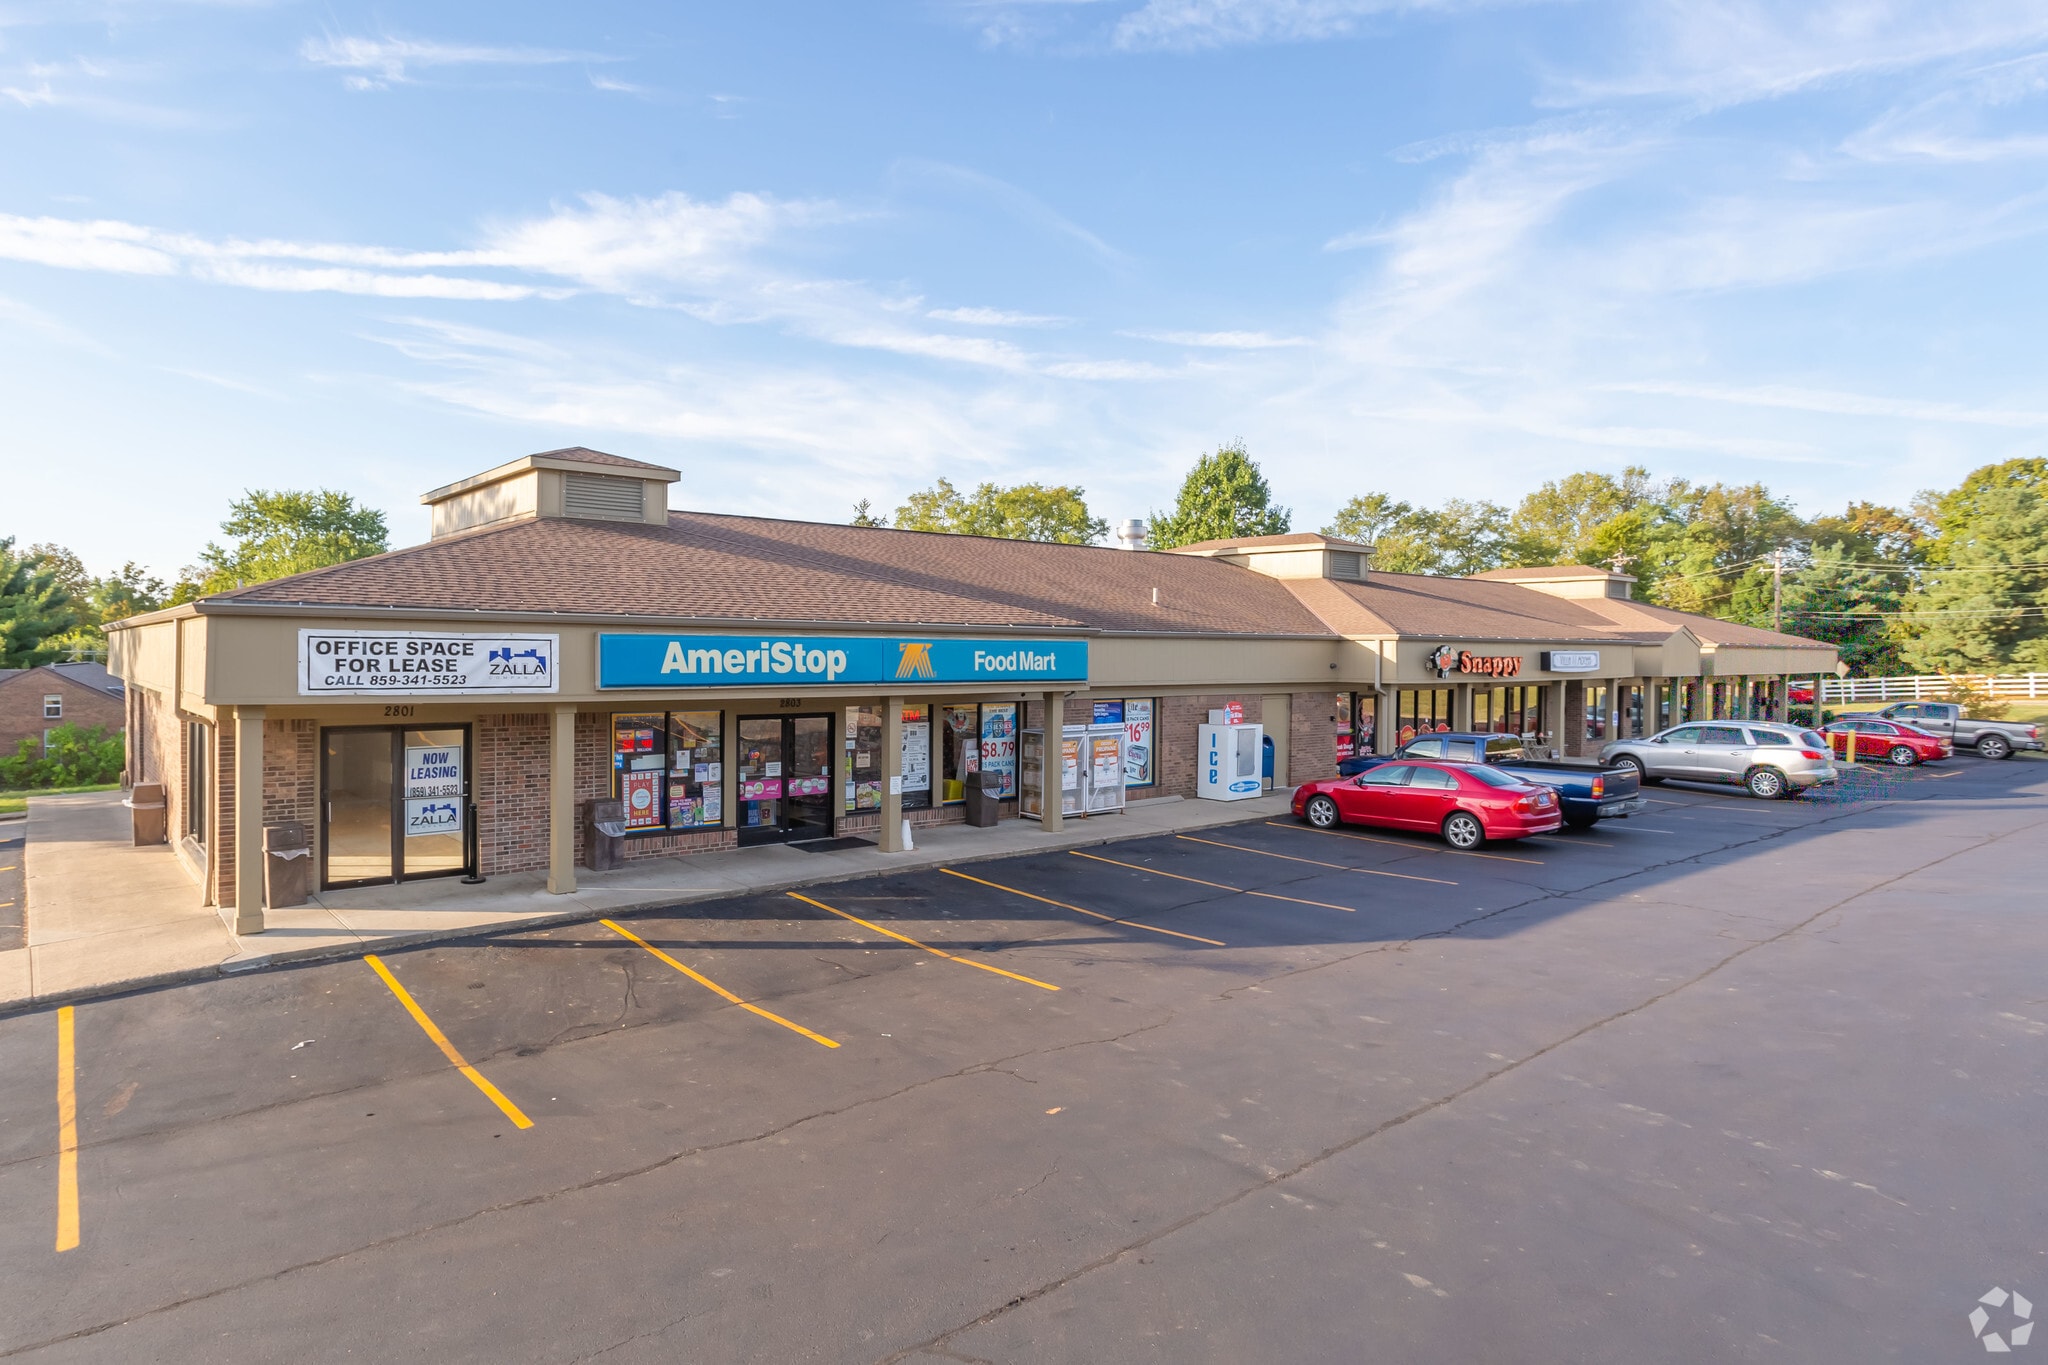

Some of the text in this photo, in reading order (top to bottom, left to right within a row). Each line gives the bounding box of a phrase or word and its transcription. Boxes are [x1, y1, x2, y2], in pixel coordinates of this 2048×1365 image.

[315, 641, 474, 656] OFFICE SPACE
[335, 658, 457, 673] FOR LEASE
[660, 641, 847, 681] AmeriStop
[974, 651, 1056, 671] Food Mart
[1461, 651, 1523, 678] Snappy
[489, 664, 545, 675] ZALLA
[325, 675, 467, 686] CALL 859-341-5523
[780, 698, 801, 708] 2803
[384, 705, 414, 717] 2801
[982, 741, 1015, 760] $8.79
[422, 752, 449, 765] NOW
[410, 766, 458, 780] LEASING
[410, 784, 459, 797] (859) 341-5523
[410, 815, 457, 826] ZALLA
